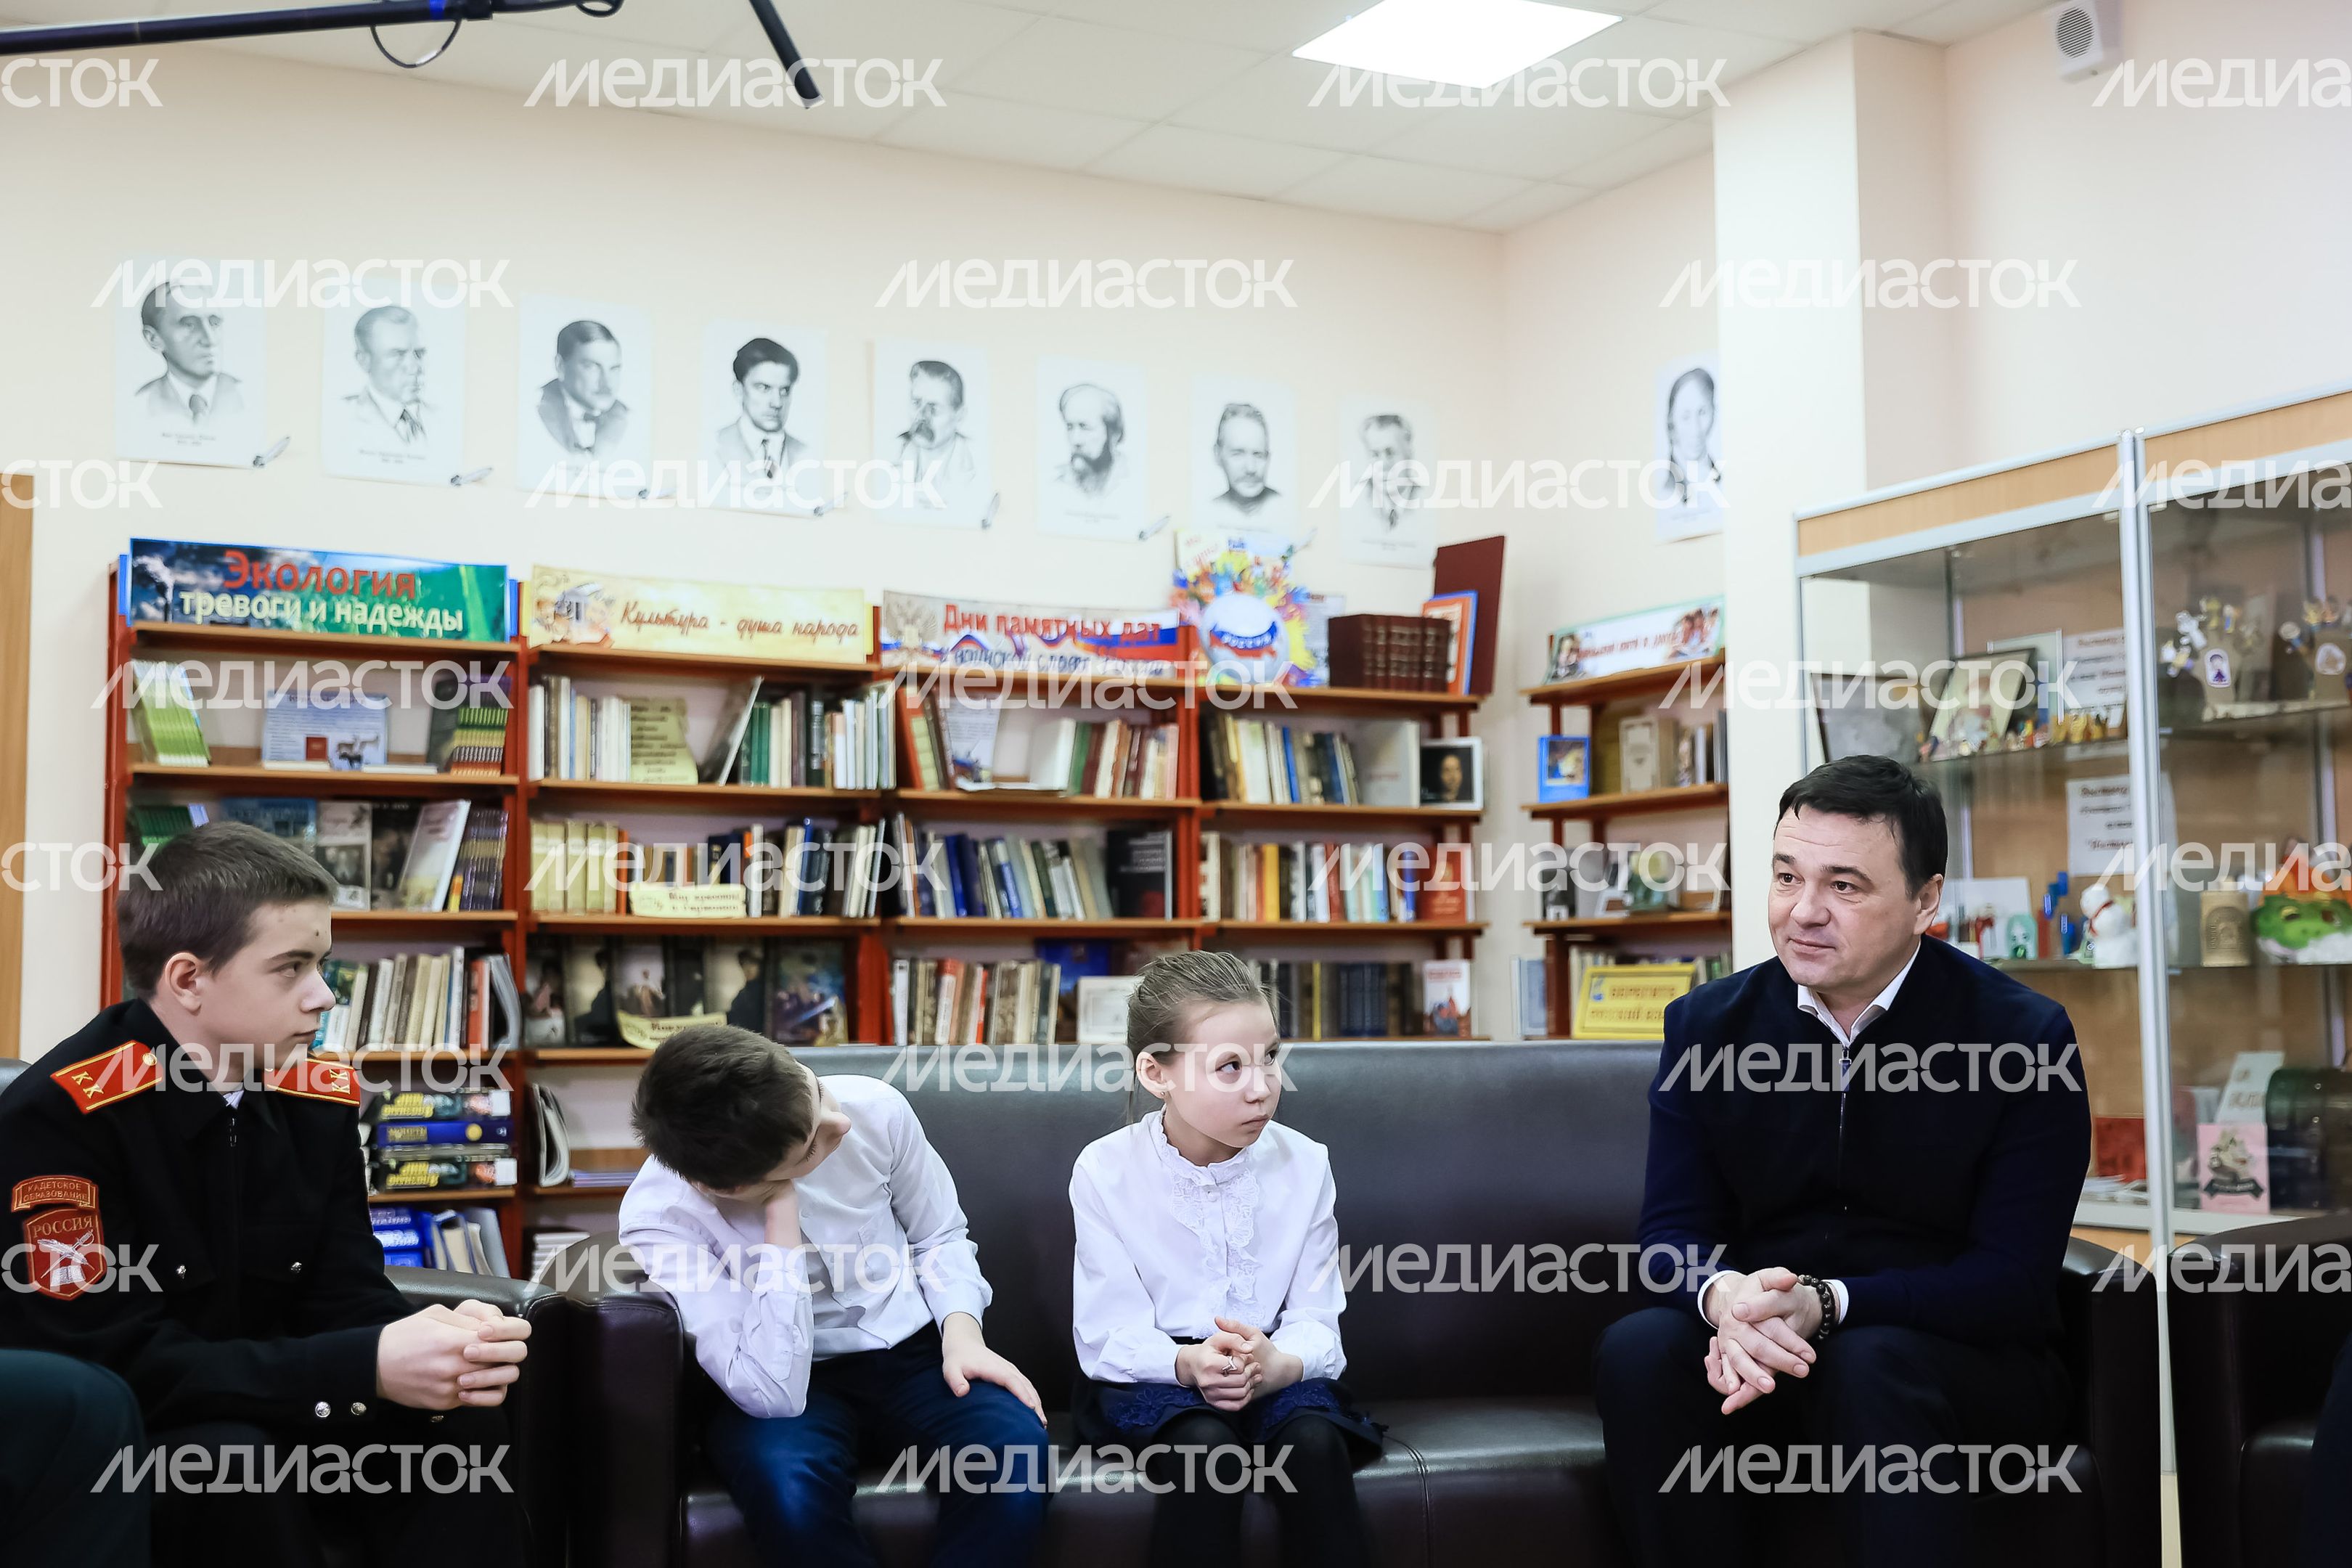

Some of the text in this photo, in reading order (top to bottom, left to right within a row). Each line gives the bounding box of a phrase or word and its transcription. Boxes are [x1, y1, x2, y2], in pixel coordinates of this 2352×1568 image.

[224, 550, 416, 600] Экология
[179, 591, 464, 639] тревоги и надежды
[621, 600, 709, 635] Культура
[738, 619, 783, 640] душа
[793, 621, 859, 644] народа
[945, 604, 987, 633] Дни
[997, 615, 1111, 637] памятных
[23, 1190, 87, 1202] ОБРАЗОВАНИЕ
[28, 1181, 81, 1191] КАДЕТСКОЕ
[33, 1216, 92, 1238] РОССИЯ
